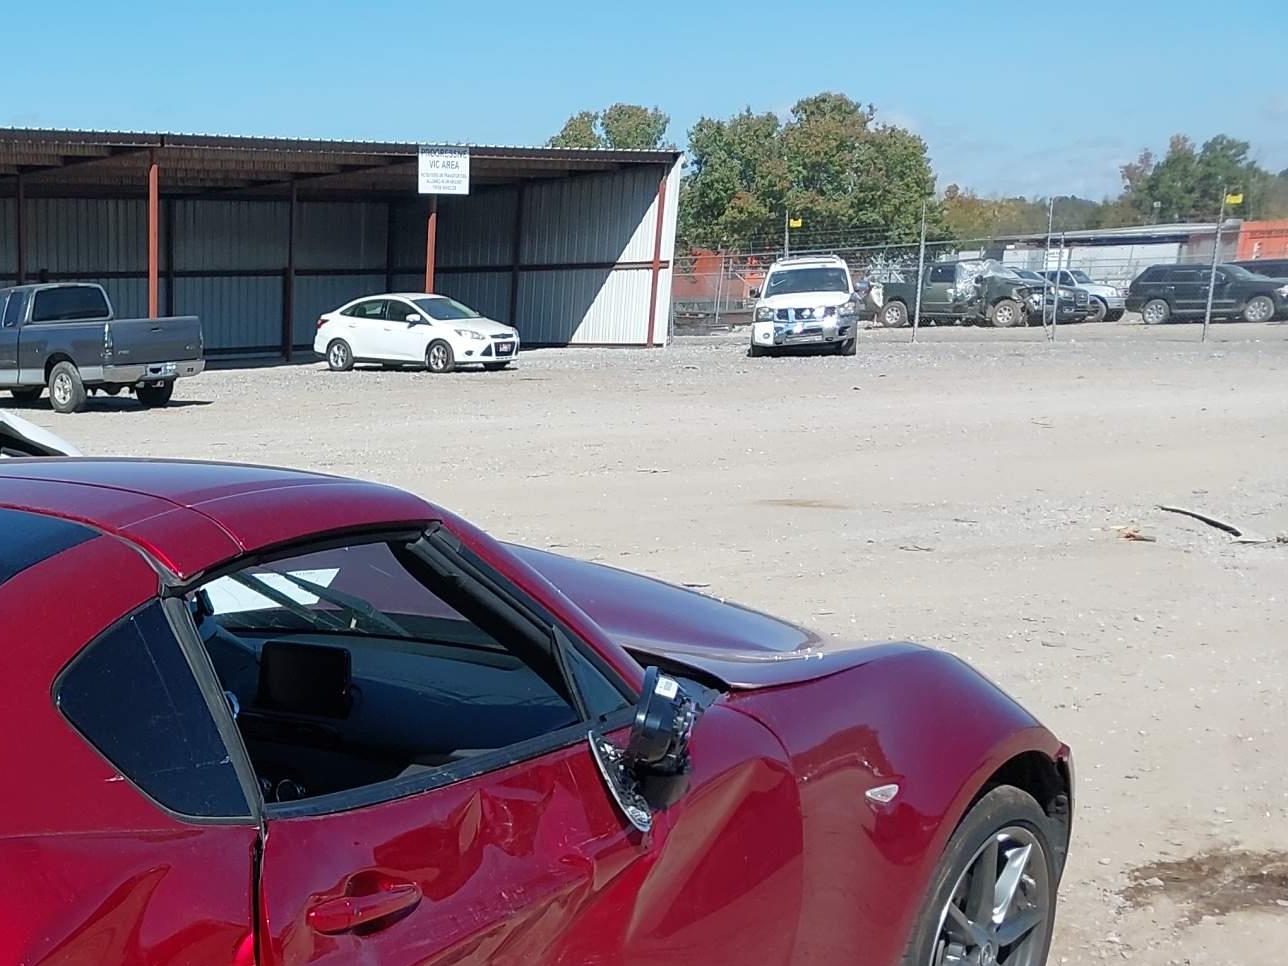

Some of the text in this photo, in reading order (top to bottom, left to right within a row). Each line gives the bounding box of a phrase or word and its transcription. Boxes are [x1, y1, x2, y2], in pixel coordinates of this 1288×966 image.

[421, 148, 468, 159] PROGRESSIVE
[429, 160, 460, 170] VIC AREA
